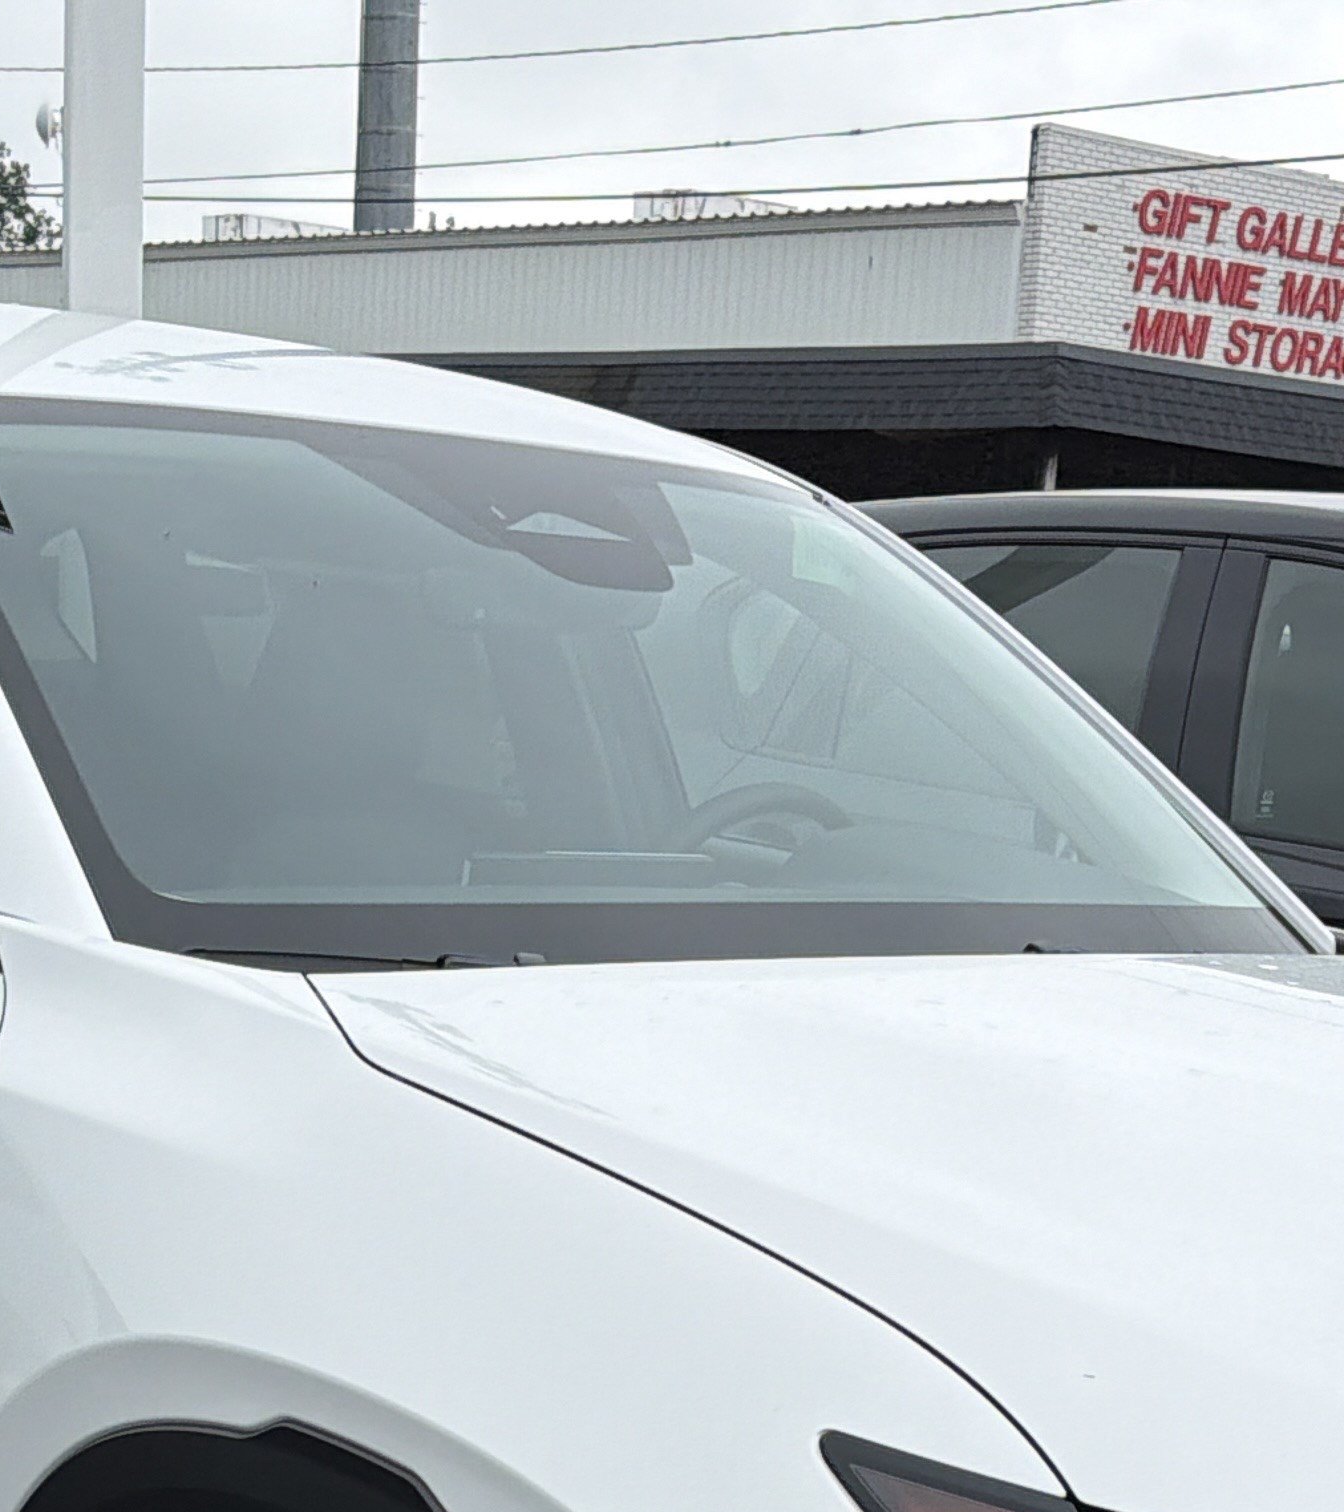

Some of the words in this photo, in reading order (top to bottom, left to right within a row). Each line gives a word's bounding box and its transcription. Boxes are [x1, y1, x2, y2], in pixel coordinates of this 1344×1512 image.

[1138, 189, 1232, 244] GIFT
[1133, 246, 1268, 310] FANNIE
[1129, 306, 1213, 360] MINI
